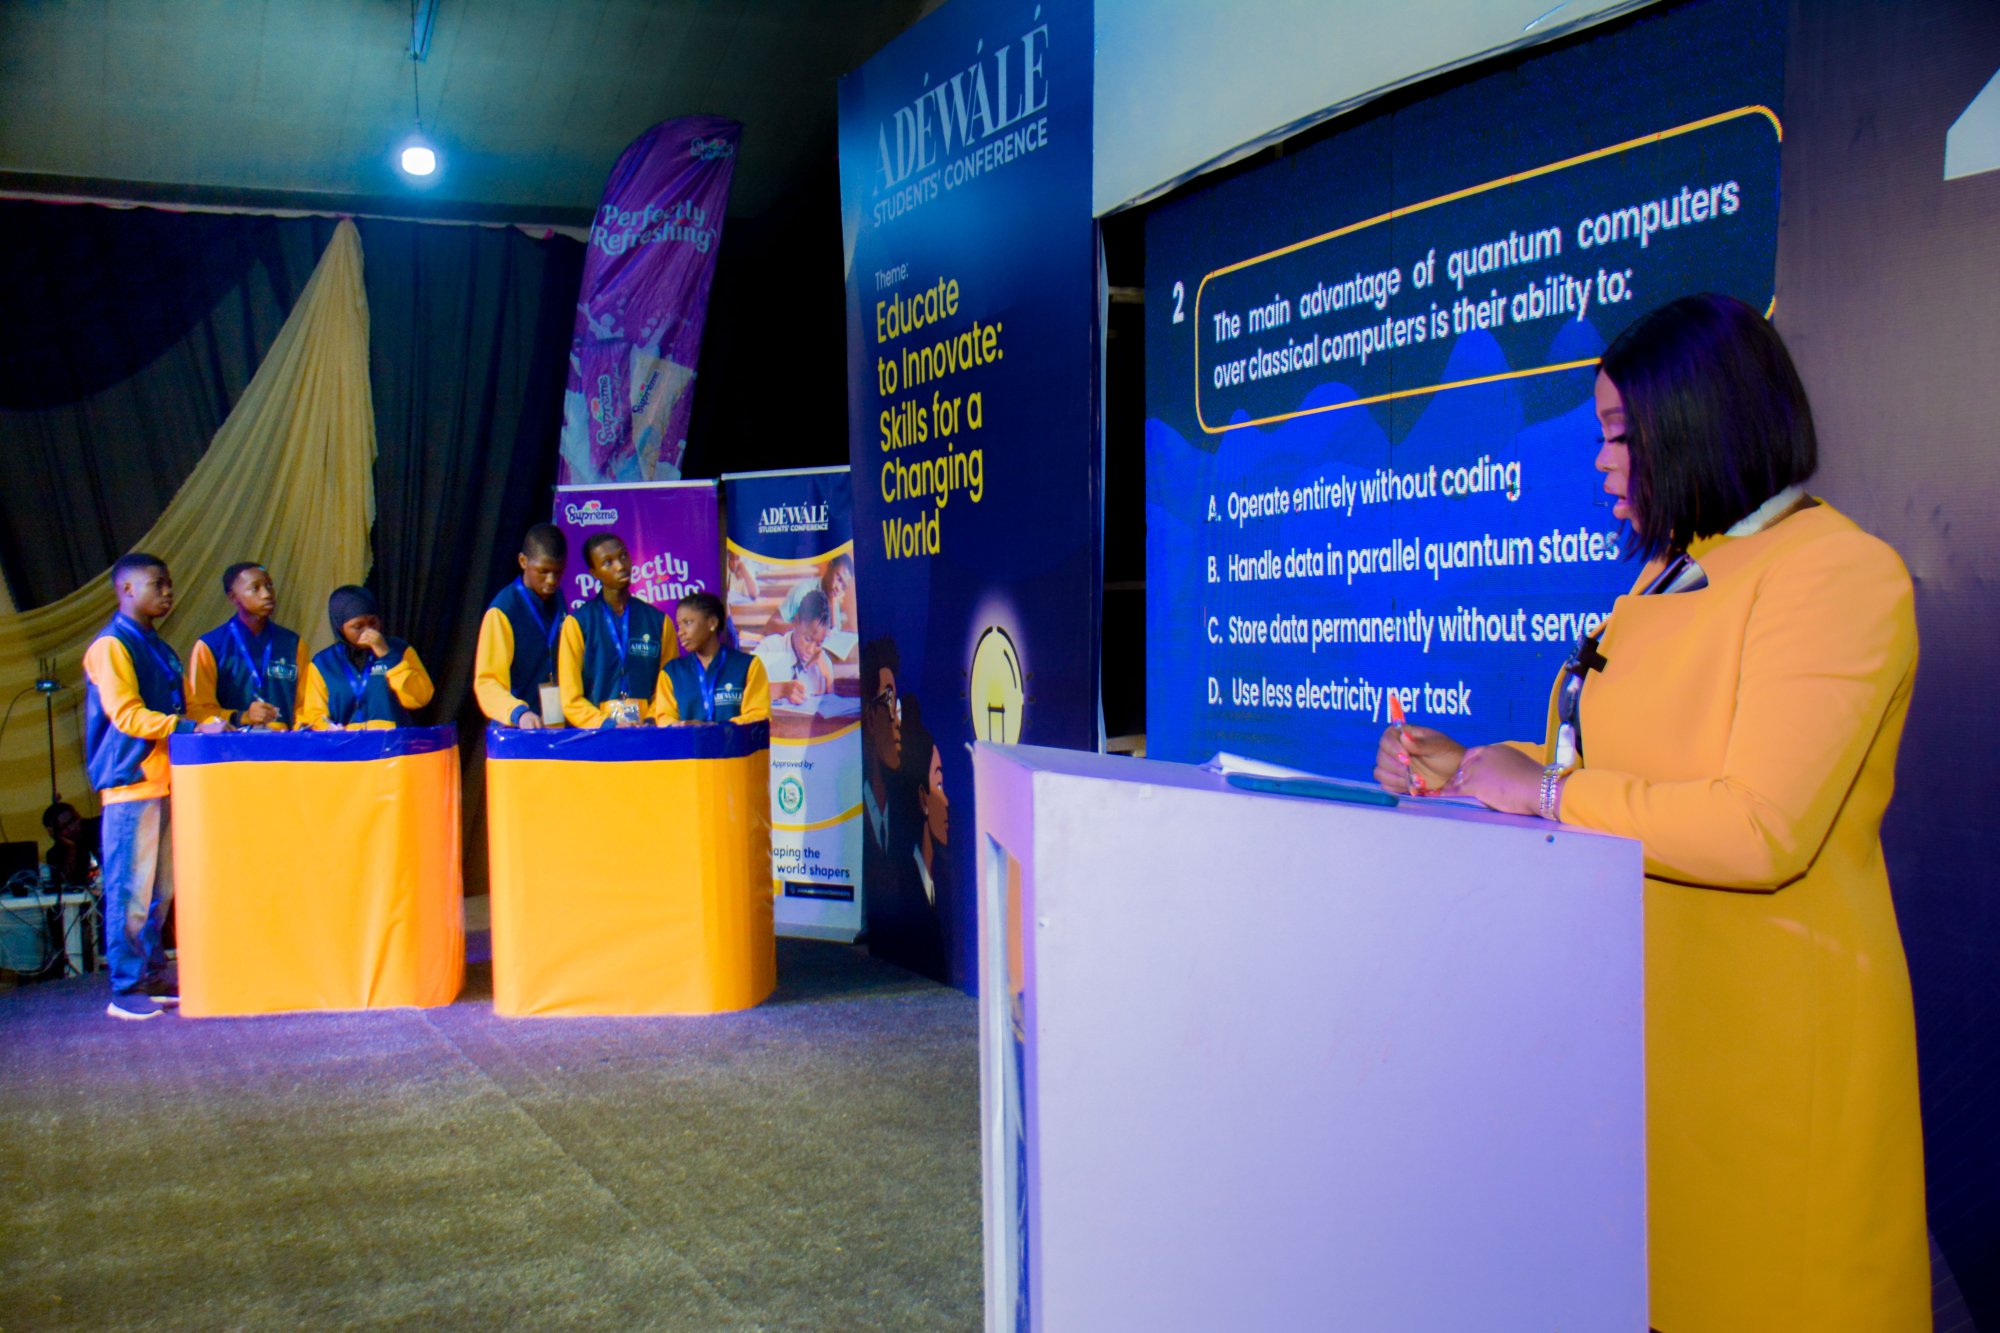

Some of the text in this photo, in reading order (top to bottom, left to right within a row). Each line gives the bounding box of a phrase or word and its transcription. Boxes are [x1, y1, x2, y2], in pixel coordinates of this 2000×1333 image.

[874, 117, 1048, 228] STUDENTS' CONFERENCE
[593, 222, 717, 256] Refreshing
[601, 200, 706, 230] Perfectly
[875, 262, 909, 291] Theme:
[1213, 180, 1740, 344] The main advantage of quantum computers
[877, 276, 960, 343] Educate
[1172, 281, 1185, 324] 2
[1213, 266, 1633, 389] over classical computers is their ability to:
[877, 321, 1003, 397] to Innovate:
[880, 391, 983, 452] Skills for a
[881, 442, 984, 508] Changing
[1207, 455, 1521, 528] A. Operate entirely without coding
[758, 523, 828, 534] STUDENTS' CONFERENCE
[882, 508, 941, 560] World
[1207, 526, 1620, 585] B. Handle data in parallel quantum states
[1207, 617, 1222, 644] C.
[1228, 615, 1267, 644] Store
[1270, 611, 1308, 644] data
[1312, 607, 1434, 653] permanently
[1438, 605, 1526, 643] without
[1208, 676, 1472, 723] D. Use less electricity per task
[772, 760, 803, 768] Approved
[777, 863, 850, 879] world shapers
[803, 847, 820, 859] the
